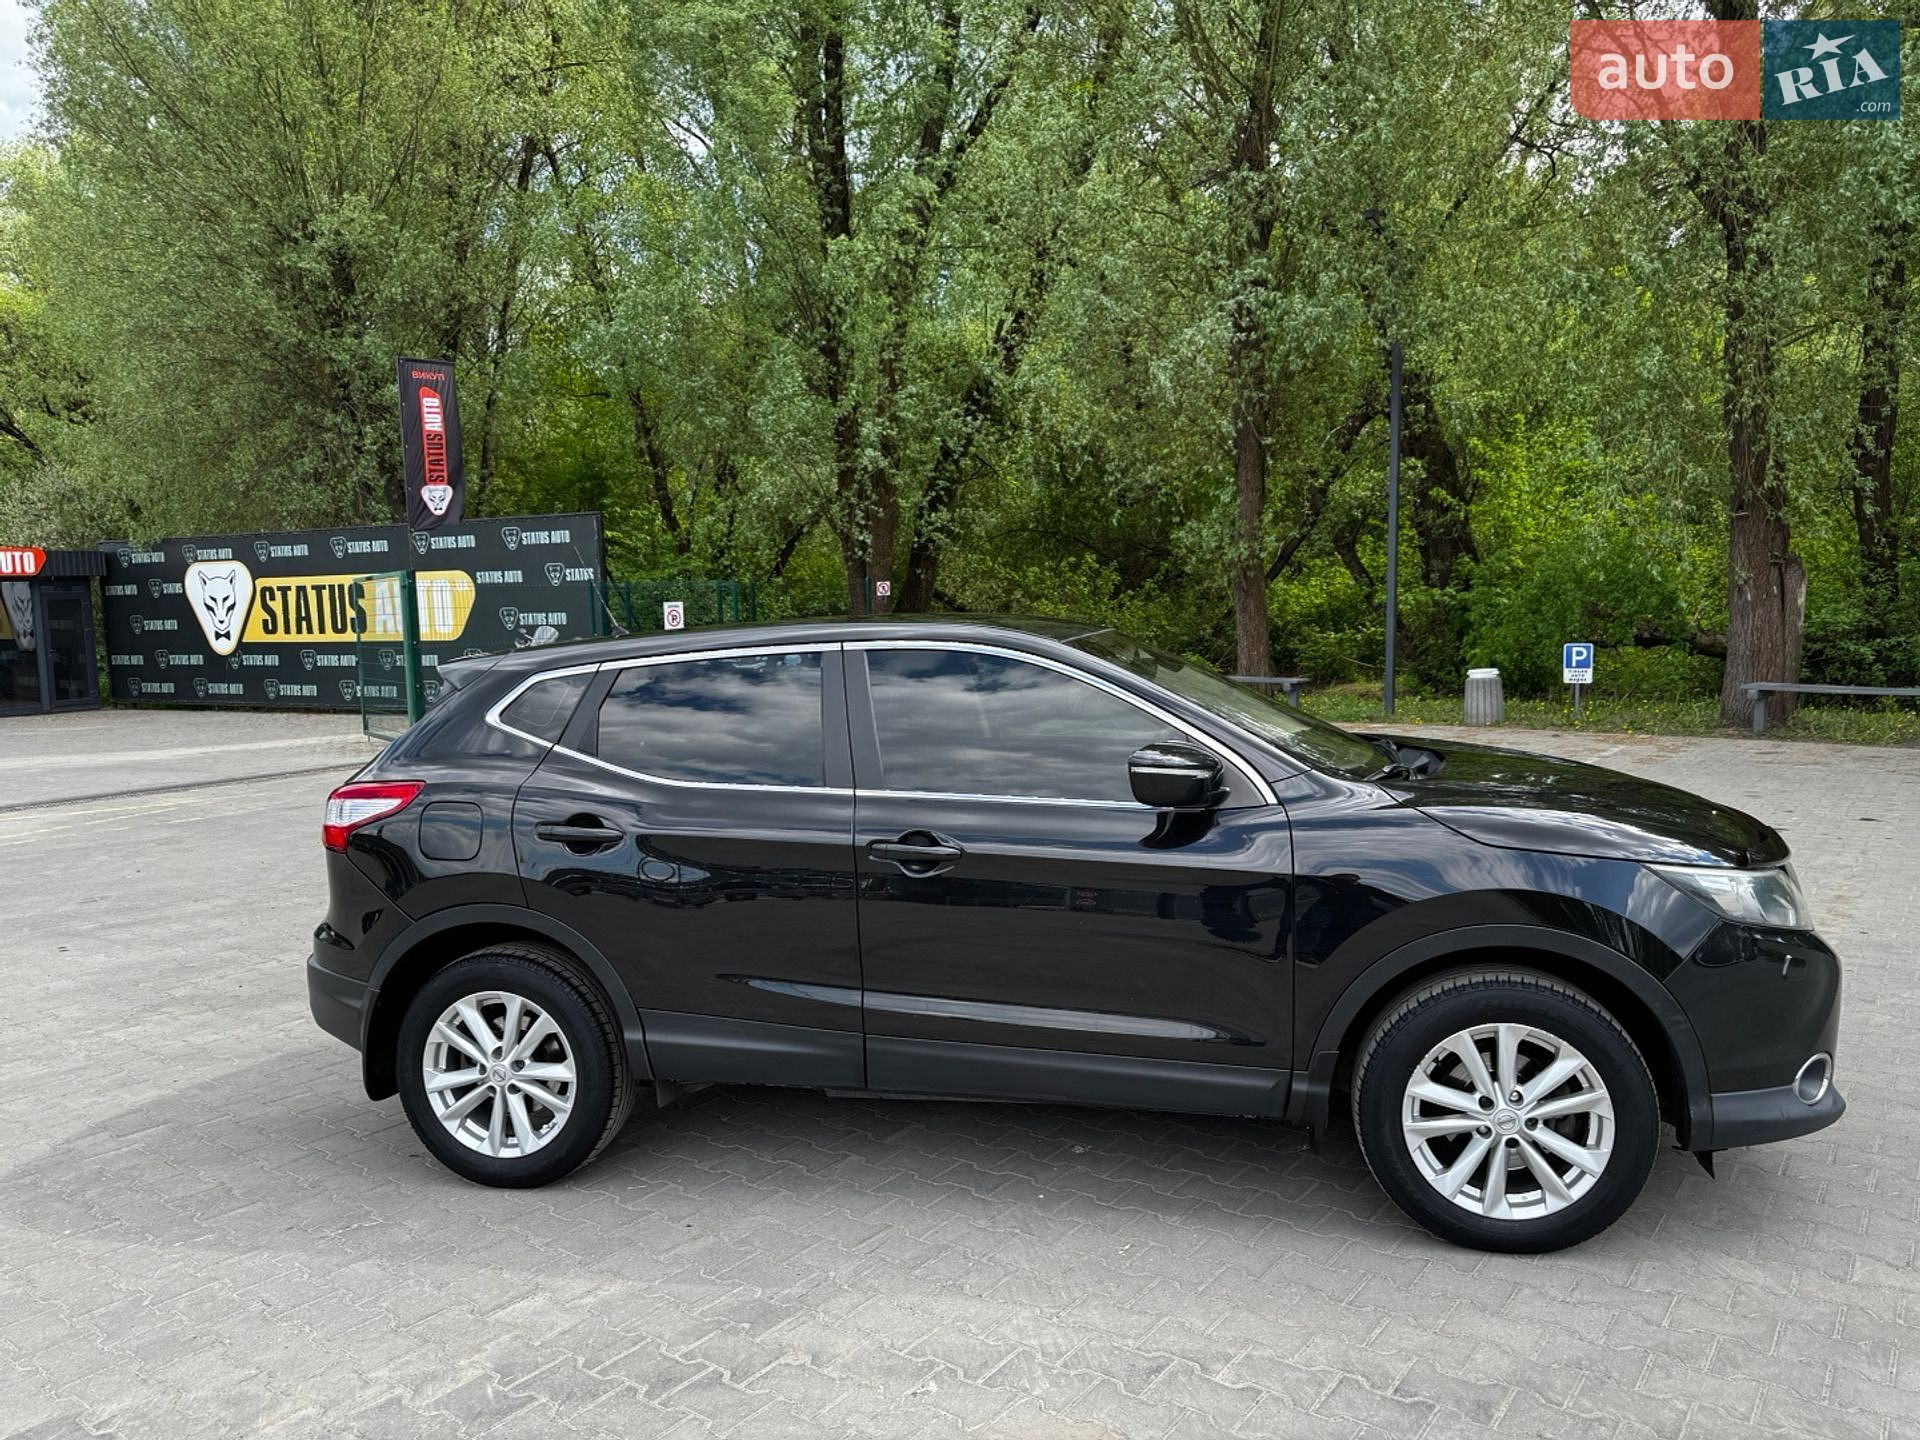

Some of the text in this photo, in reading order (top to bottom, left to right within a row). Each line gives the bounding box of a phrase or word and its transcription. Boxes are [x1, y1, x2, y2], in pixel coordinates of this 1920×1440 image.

[423, 397, 445, 483] STATUS AUTO
[431, 534, 475, 549] STATUS AUTO
[522, 530, 571, 545] STATUS AUTO
[270, 544, 309, 557] STATUS AUTO
[347, 540, 389, 553] STATUS AUTO
[0, 551, 36, 574] UTO
[476, 570, 523, 584] STATUS AUTO
[260, 584, 367, 634] STATUS
[519, 612, 568, 625] STATUS AUTO
[242, 655, 279, 666] STATUS AUTO
[316, 655, 356, 666] STATUS AUTO
[1572, 646, 1587, 667] P
